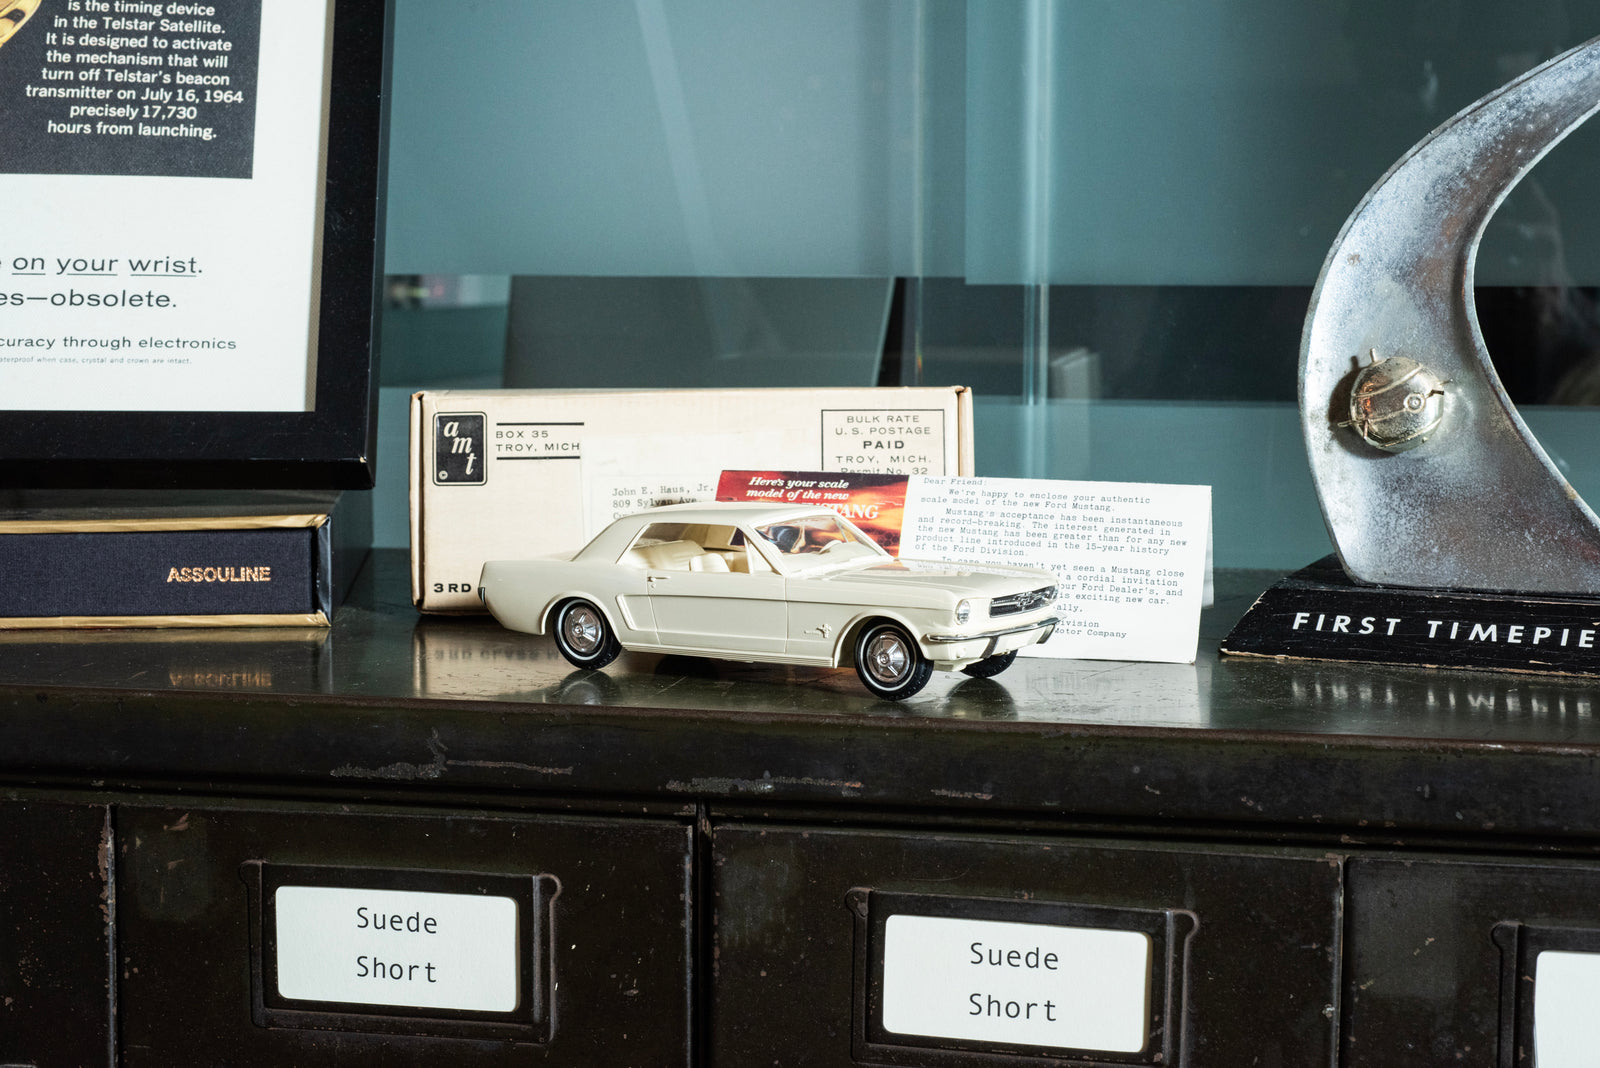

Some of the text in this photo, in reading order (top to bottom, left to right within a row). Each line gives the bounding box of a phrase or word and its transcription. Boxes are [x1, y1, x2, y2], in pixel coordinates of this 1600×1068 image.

[67, 0, 216, 17] is the timing device
[54, 15, 226, 34] in the Telstar Satellite.
[46, 32, 233, 51] It is designed to activate
[46, 49, 229, 69] the mechanism that will
[41, 67, 230, 86] turn off Telstar's beacon
[25, 84, 245, 104] transmitter on July 16, 1964
[69, 103, 198, 121] precisely 17,730
[47, 119, 218, 141] hours from launching.
[12, 257, 45, 271] on
[56, 257, 119, 275] your
[128, 256, 203, 274] wrist.
[63, 336, 131, 351] through
[138, 336, 237, 350] electronics
[37, 356, 57, 364] when
[81, 356, 107, 366] crystal
[109, 357, 124, 365] and
[846, 415, 920, 423] BULK RATE
[496, 430, 549, 439] BOX 35
[869, 426, 931, 435] POSTAGE
[496, 441, 581, 453] TROY, MICH
[863, 440, 905, 449] PAID
[835, 455, 932, 464] TROY, MICH.
[886, 467, 906, 475] No.
[911, 467, 928, 475] 32
[748, 476, 850, 489] Here's your scale
[924, 477, 946, 485] Dear
[612, 487, 637, 497] John
[641, 486, 653, 495] E.
[696, 483, 714, 492] Jr.
[746, 488, 850, 501] model of the new
[981, 489, 1008, 499] happy
[1014, 491, 1025, 499] to
[1029, 492, 1068, 501] enclose
[1073, 493, 1096, 503] your
[1100, 495, 1151, 504] authentic
[612, 499, 631, 508] 809
[637, 498, 673, 509] Sylvan
[920, 496, 948, 504] scale
[952, 497, 979, 505] model
[985, 498, 997, 506] of
[1002, 499, 1018, 507] the
[1044, 501, 1067, 509] Ford
[1000, 511, 1055, 521] acceptance
[1060, 513, 1077, 522] has
[1082, 515, 1105, 523] been
[1110, 516, 1183, 528] instantaneous
[917, 524, 1187, 546] the new Mustang has been greater than for any new
[1031, 521, 1049, 530] The
[1054, 522, 1098, 532] interest
[1103, 526, 1154, 535] generated
[1159, 528, 1171, 536] in
[915, 534, 1170, 556] product line introduced in the 15-year history
[952, 545, 975, 553] Ford
[166, 566, 272, 583] ASSOULINE
[1050, 563, 1067, 572] yet
[1072, 565, 1095, 573] seen
[1111, 565, 1151, 577] Mustang
[1156, 568, 1185, 577] close
[1077, 574, 1116, 583] cordial
[1121, 576, 1178, 587] invitation
[433, 583, 473, 593] 3RD
[1081, 583, 1104, 592] Ford
[1165, 588, 1183, 597] and
[1075, 593, 1121, 604] exciting
[1086, 628, 1127, 639] Company
[1292, 611, 1596, 649] FIRST TIMEPIE
[356, 906, 439, 935] Suede
[969, 942, 1060, 971] Suede
[356, 955, 438, 984] Short
[968, 993, 1058, 1022] Short
